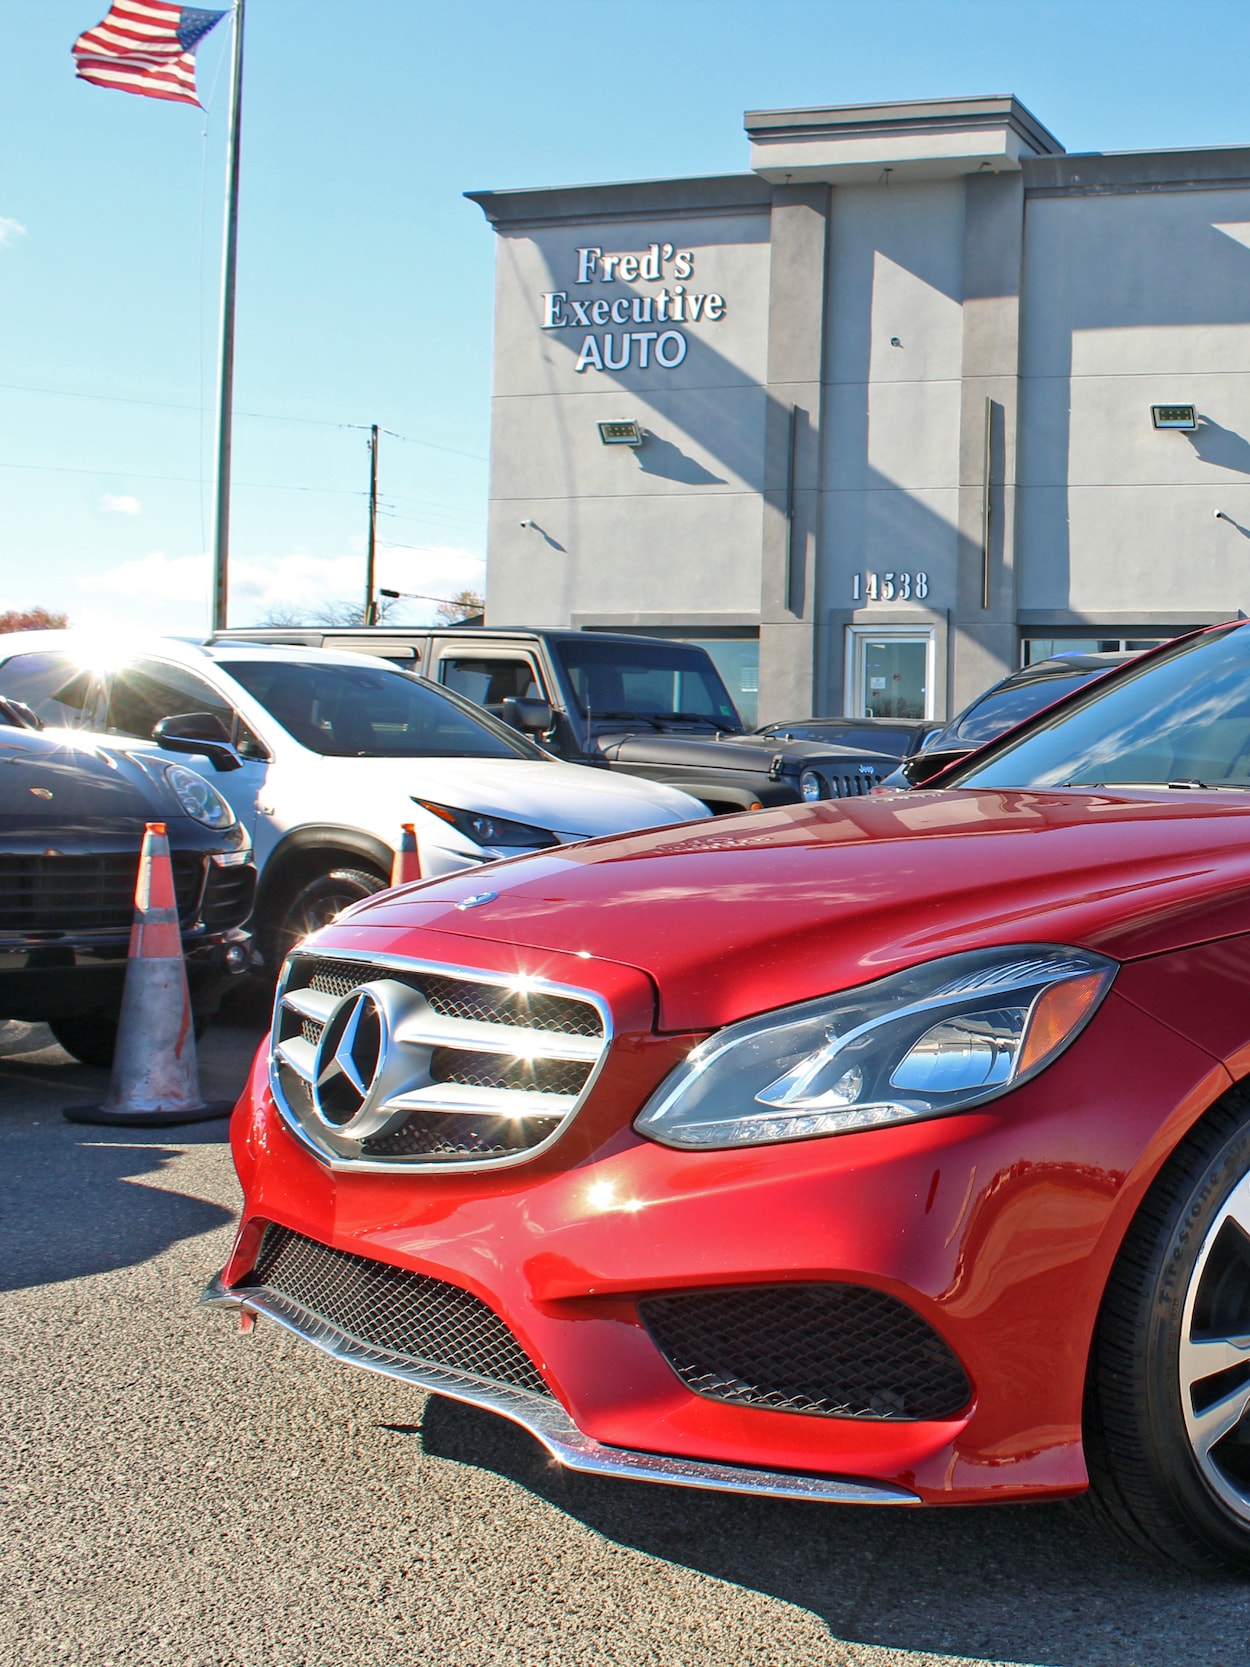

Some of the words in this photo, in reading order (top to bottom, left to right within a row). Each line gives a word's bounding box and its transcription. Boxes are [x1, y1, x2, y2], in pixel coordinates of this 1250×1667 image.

[574, 242, 694, 284] Fred's
[540, 285, 726, 329] Executive
[574, 329, 688, 372] AUTO
[852, 571, 929, 600] 14538
[858, 764, 875, 775] Jeep
[1158, 1171, 1219, 1305] Firestone
